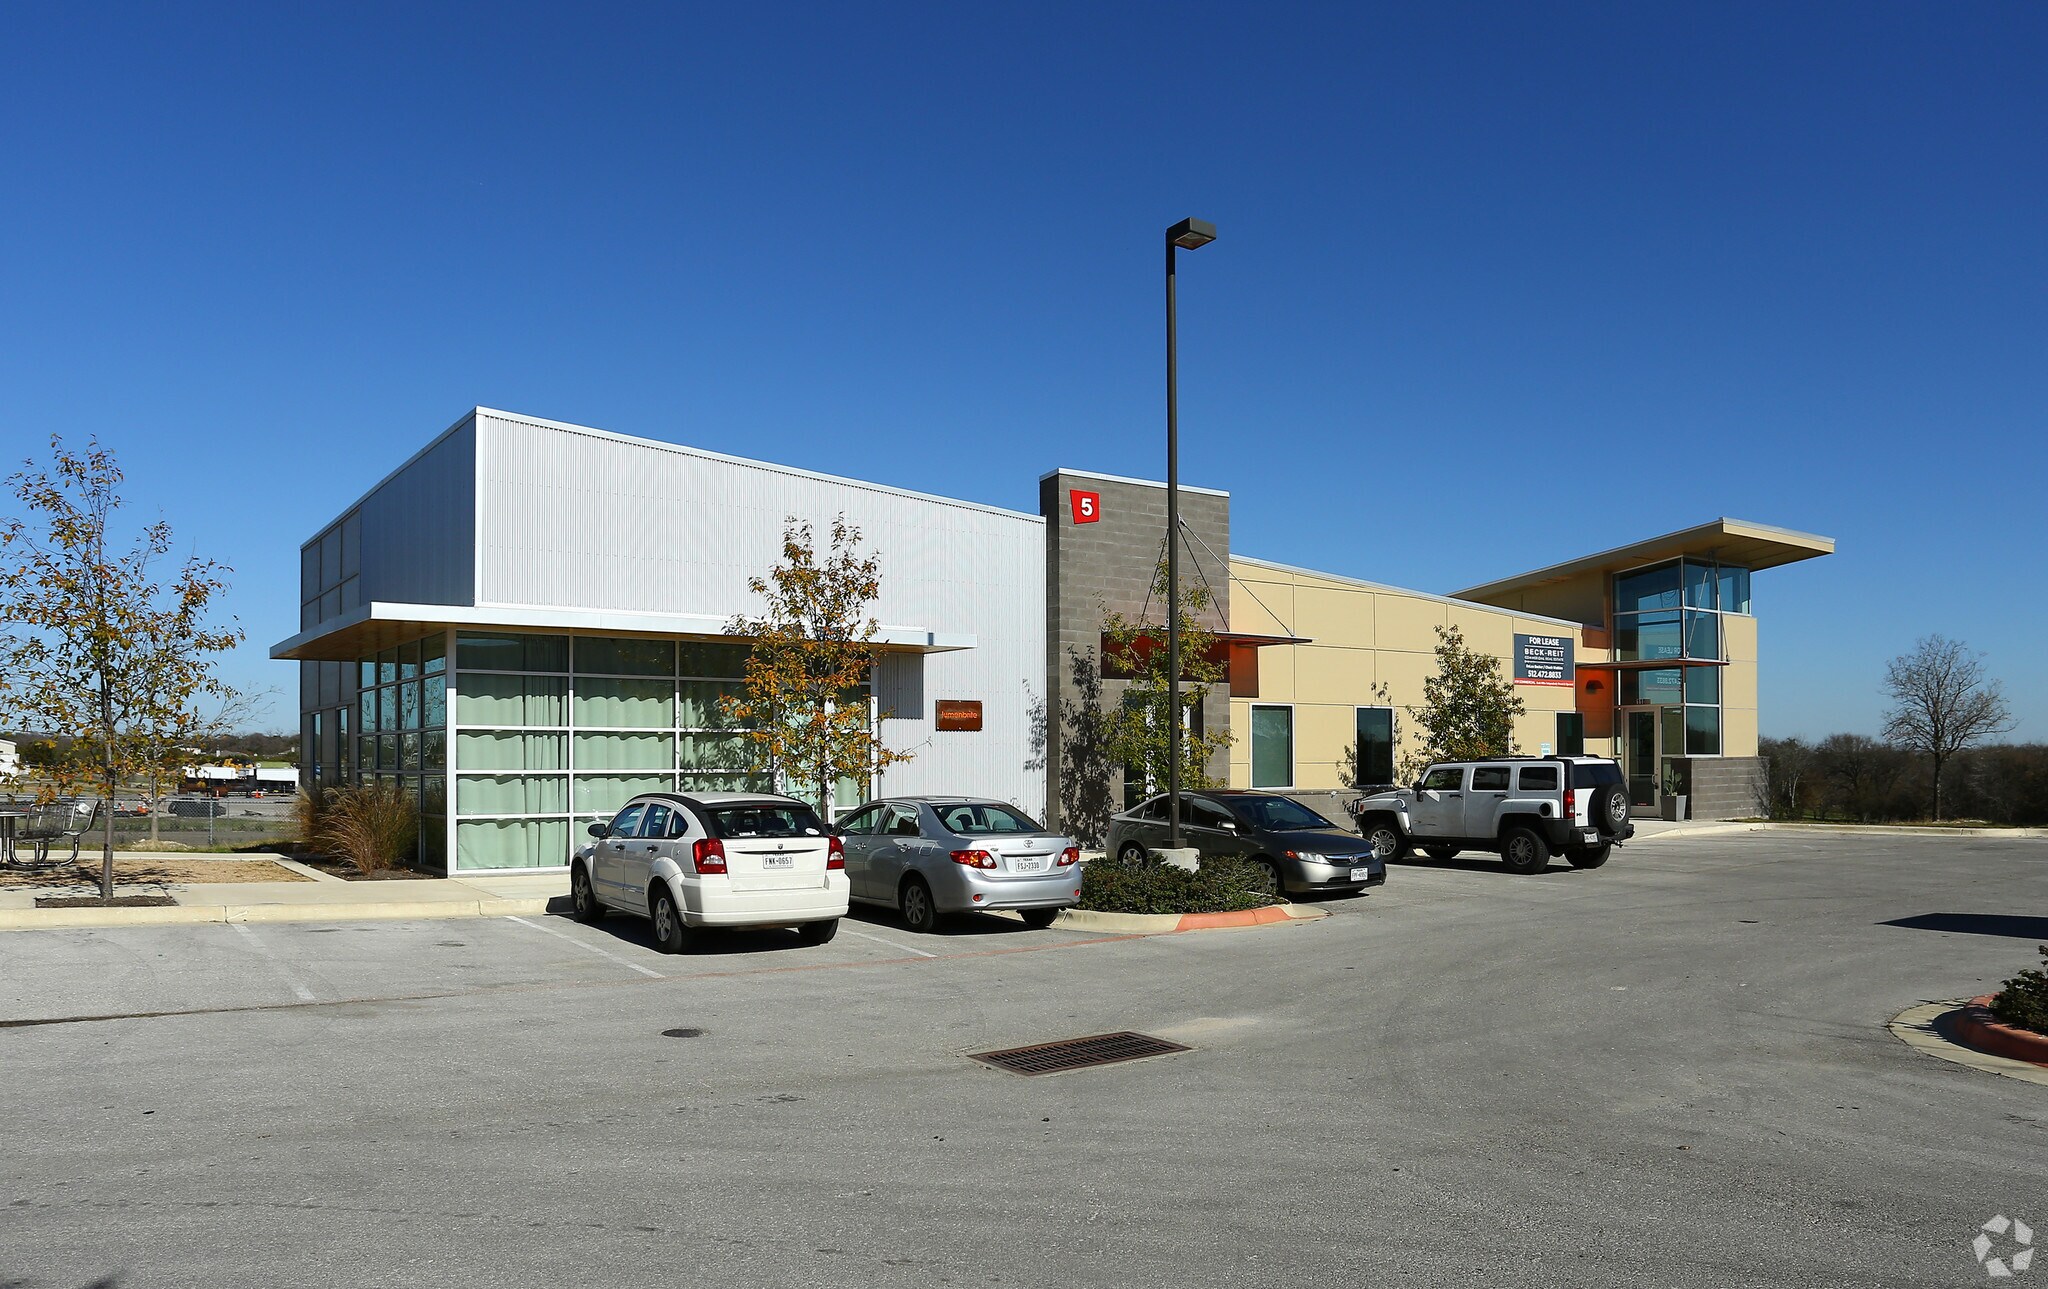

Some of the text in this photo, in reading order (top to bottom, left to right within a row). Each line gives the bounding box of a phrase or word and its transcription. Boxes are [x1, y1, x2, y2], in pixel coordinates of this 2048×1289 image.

[1081, 497, 1093, 516] 5
[1529, 637, 1560, 646] FOR LEASE
[1524, 648, 1564, 657] BECK-REIT
[1528, 670, 1562, 679] 512.472.8833
